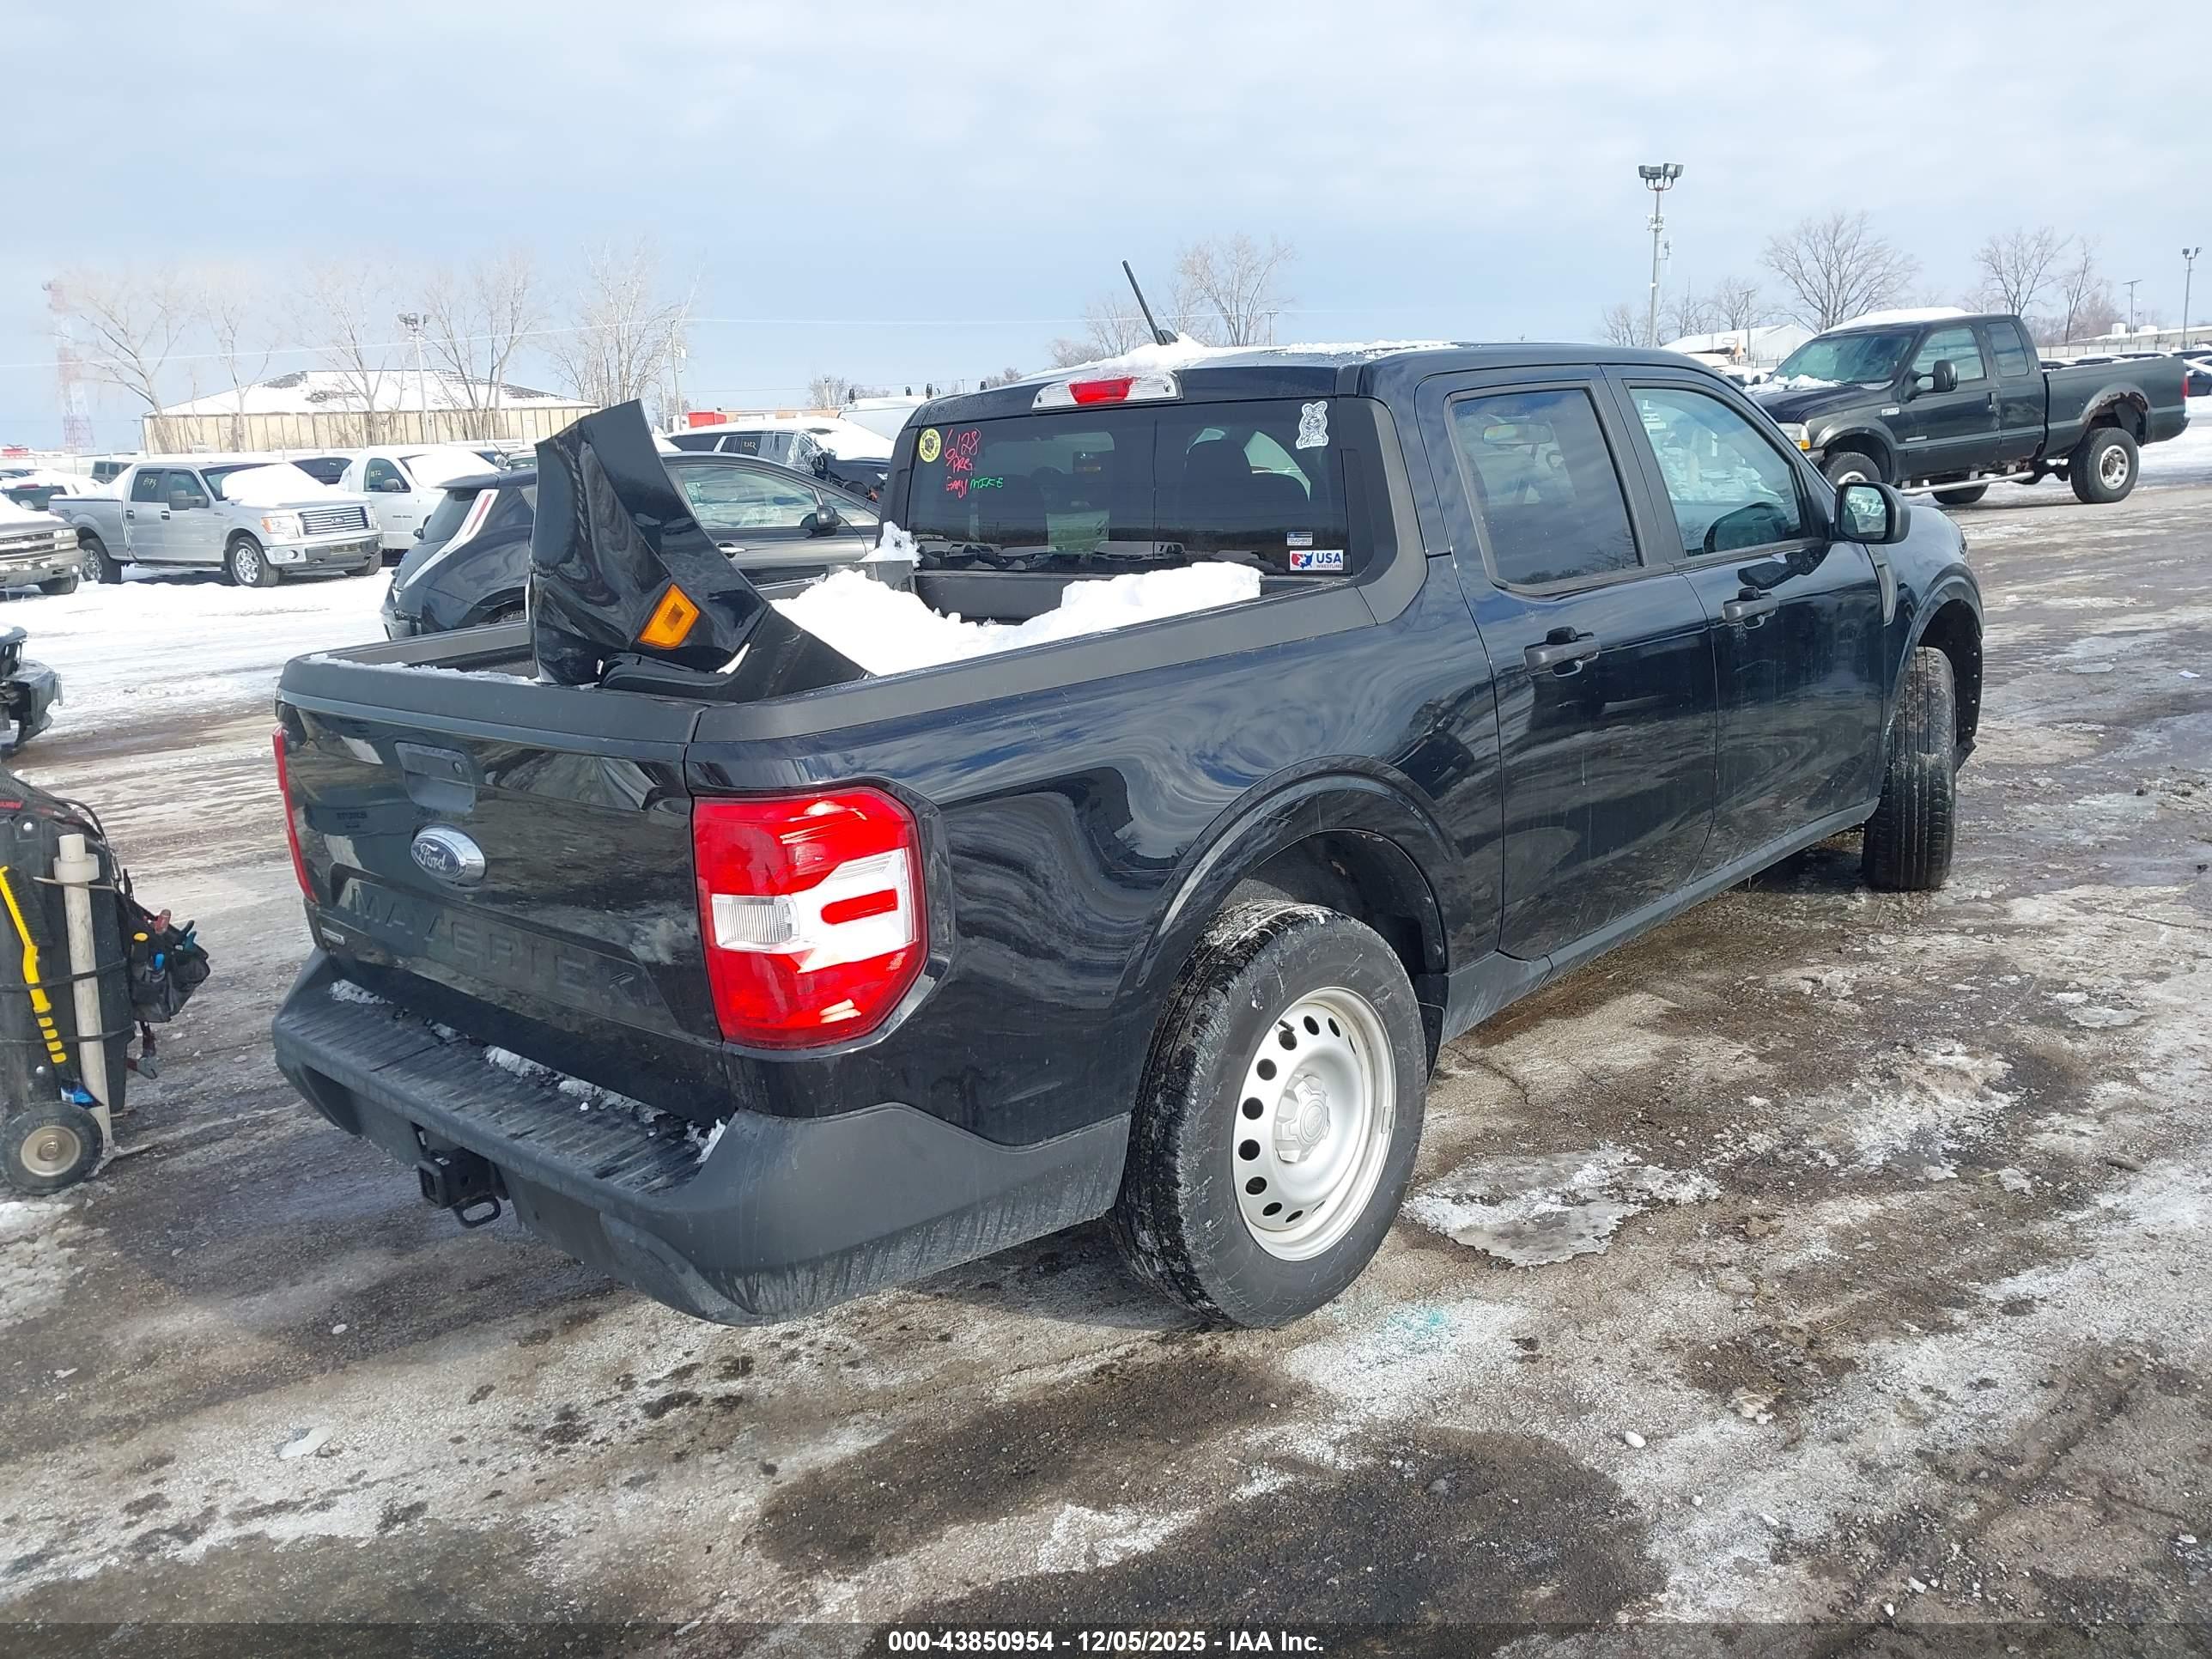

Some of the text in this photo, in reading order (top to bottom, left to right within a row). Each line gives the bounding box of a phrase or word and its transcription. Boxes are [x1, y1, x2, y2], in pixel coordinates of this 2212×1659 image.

[944, 428, 981, 459] 6128
[1316, 552, 1342, 564] USA
[415, 842, 447, 872] Ford
